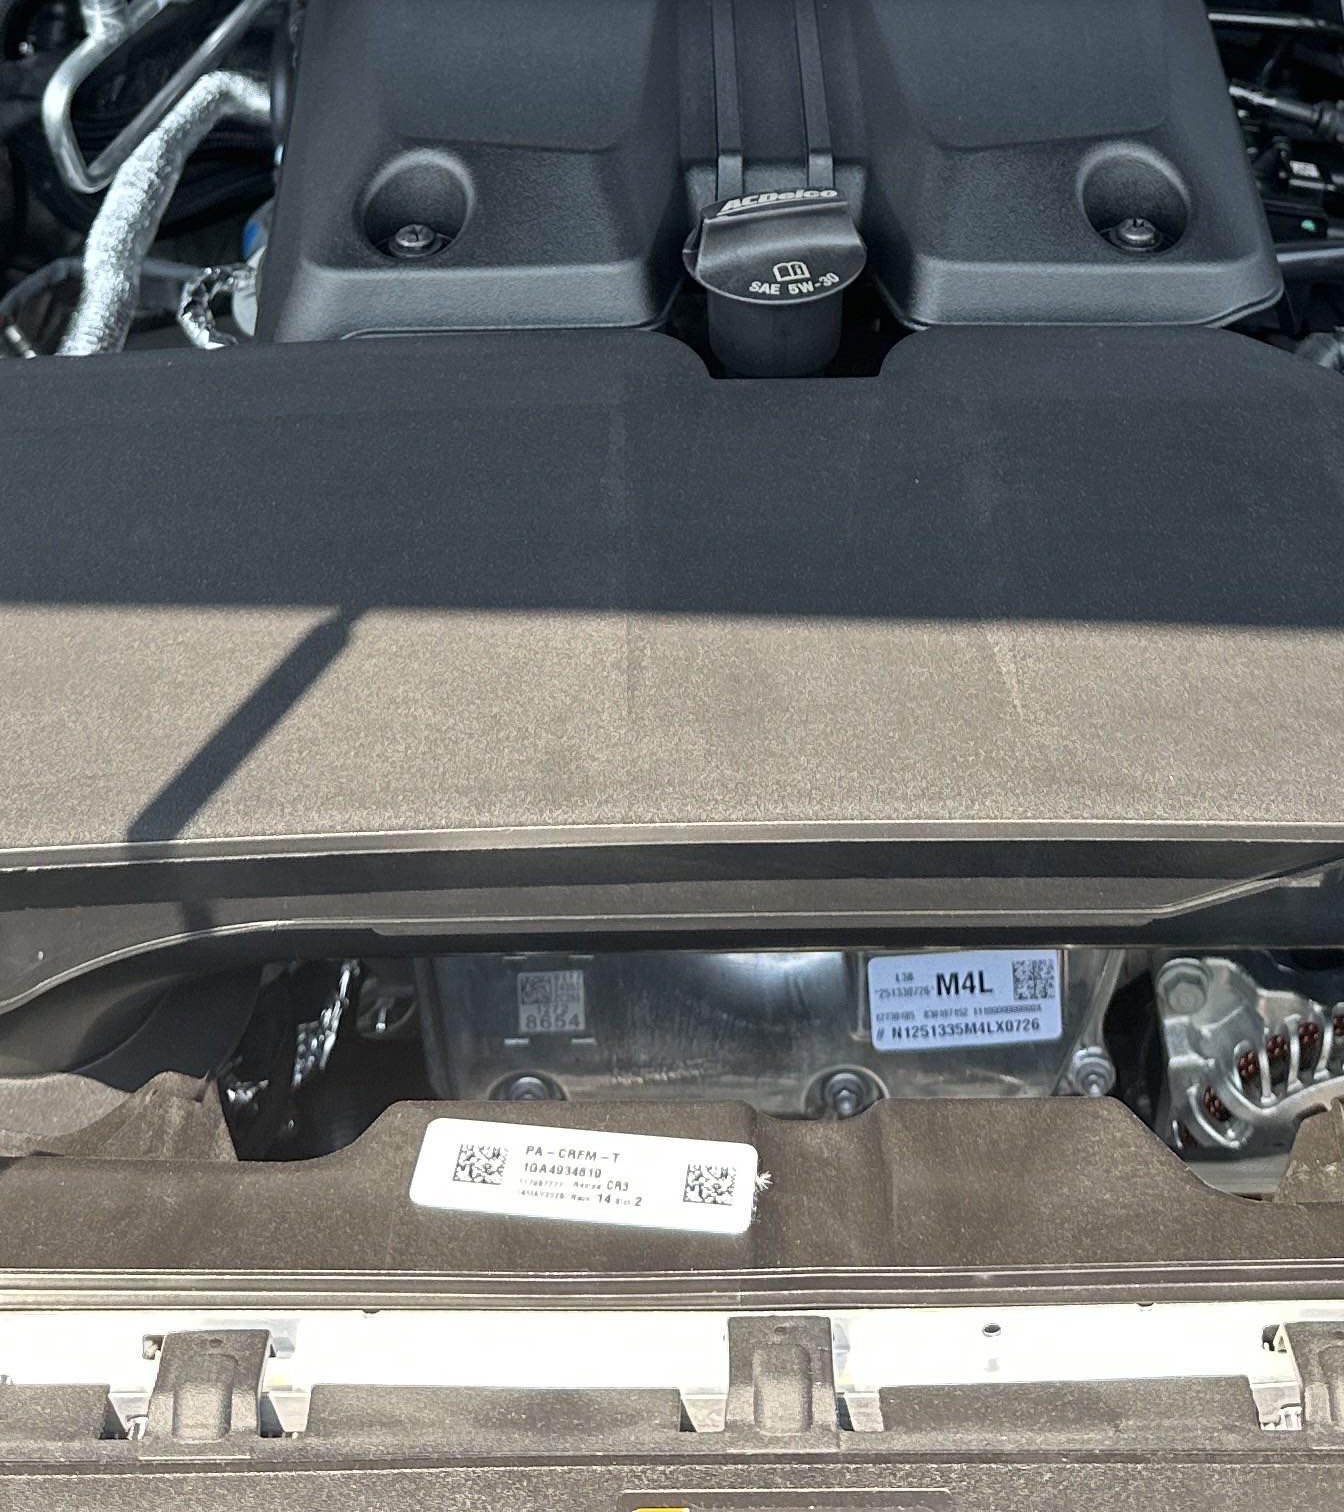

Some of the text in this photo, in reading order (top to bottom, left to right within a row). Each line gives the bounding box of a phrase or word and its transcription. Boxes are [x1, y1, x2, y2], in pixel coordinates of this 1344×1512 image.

[721, 189, 838, 212] ACDelco
[749, 272, 840, 295] SAE 5W-30
[936, 970, 993, 996] M4L
[598, 1193, 611, 1204] 14
[634, 1197, 642, 1207] 2
